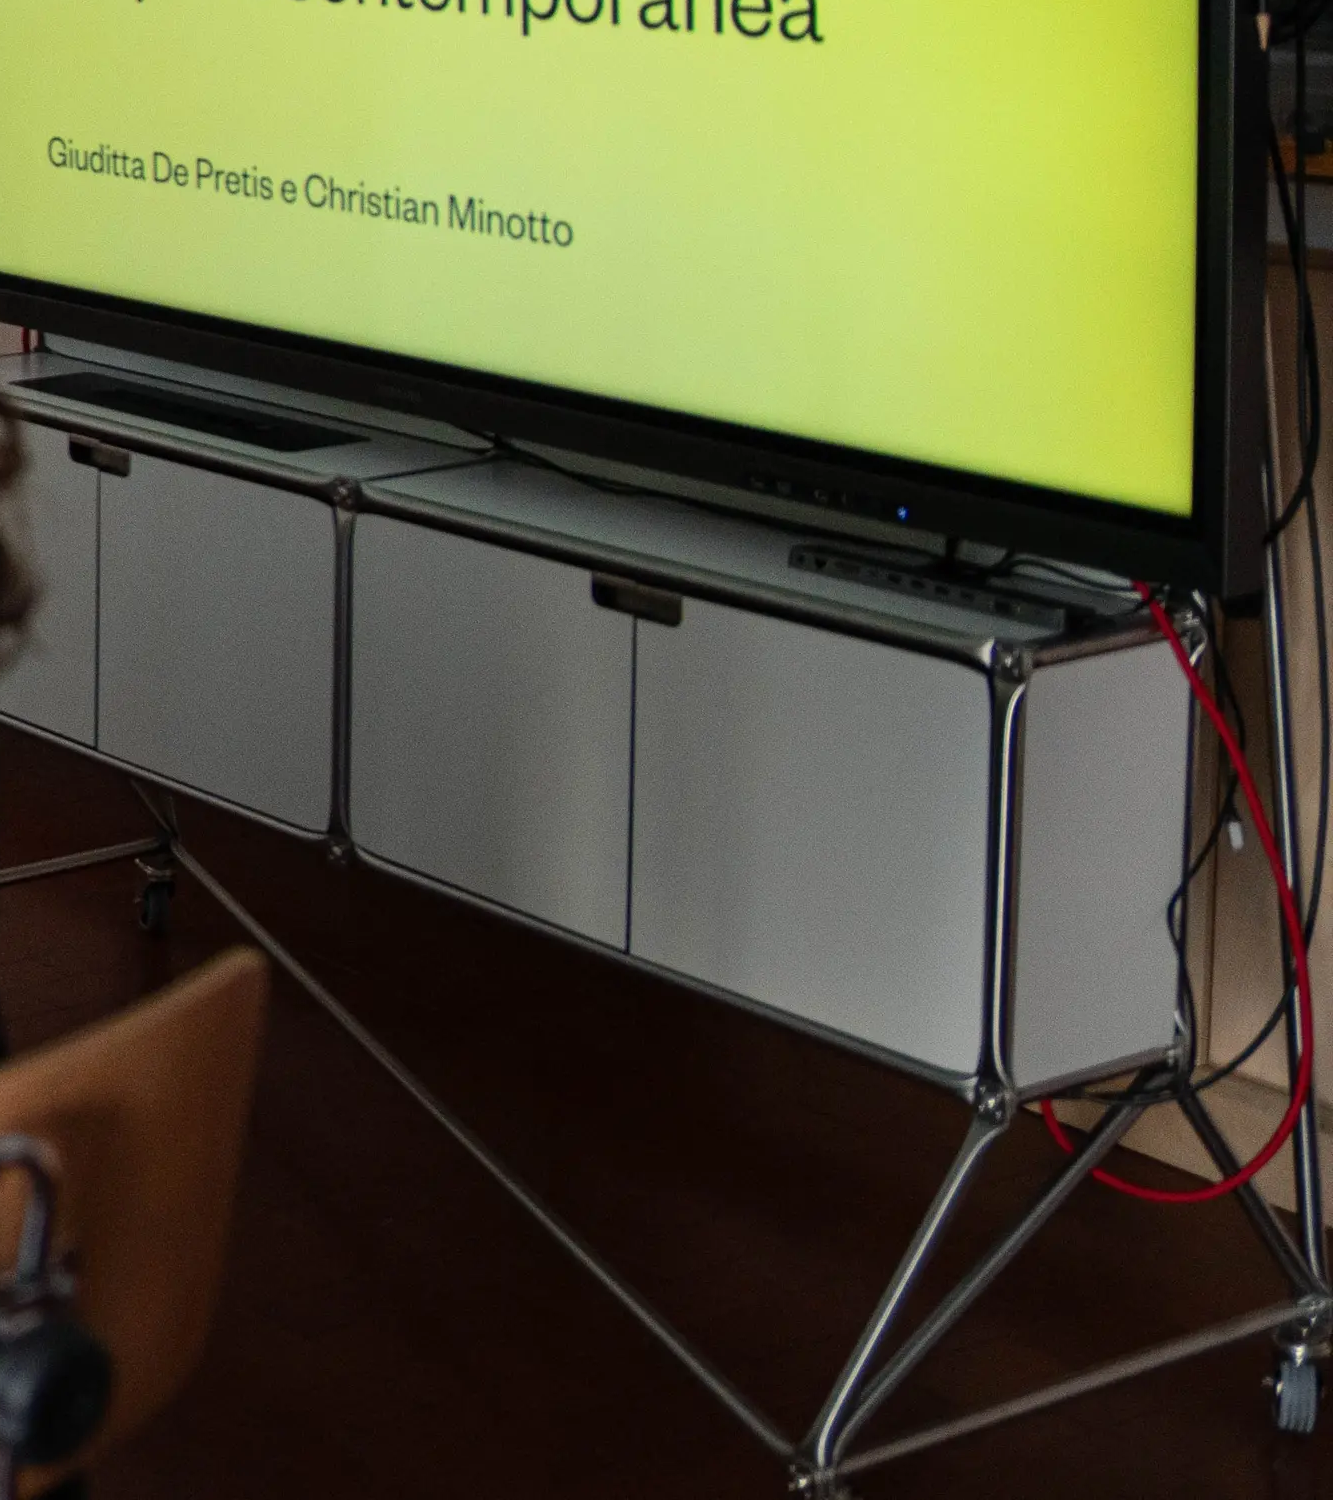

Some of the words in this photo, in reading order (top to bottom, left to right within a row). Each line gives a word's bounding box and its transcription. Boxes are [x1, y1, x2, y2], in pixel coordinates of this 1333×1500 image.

[47, 136, 146, 181] Giuditta
[152, 151, 190, 187] De
[196, 157, 274, 201] Pretis
[280, 178, 298, 205] e
[303, 173, 439, 227] Christian
[448, 193, 574, 248] Minotto
